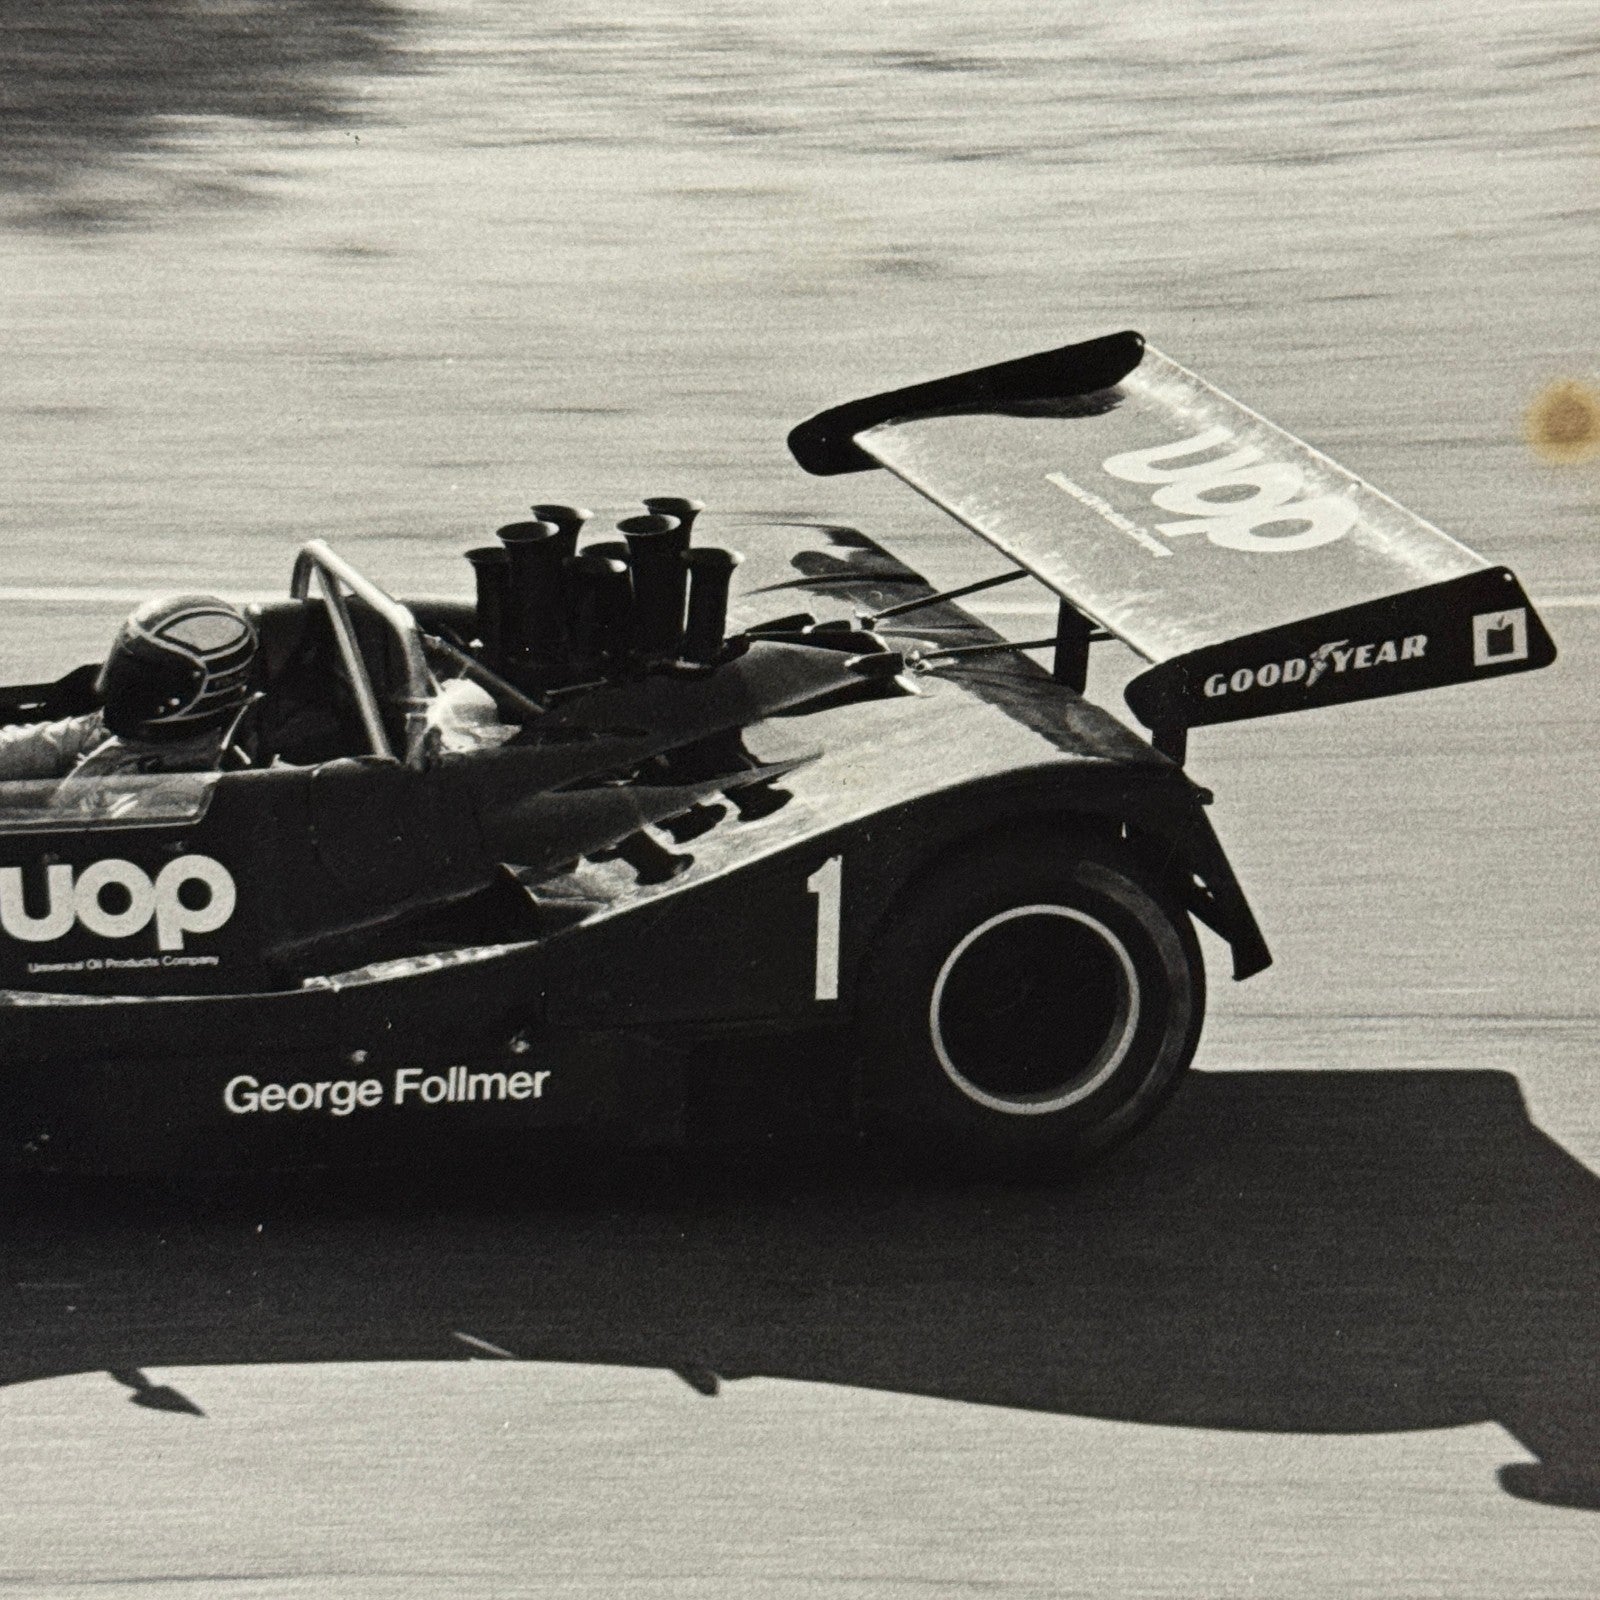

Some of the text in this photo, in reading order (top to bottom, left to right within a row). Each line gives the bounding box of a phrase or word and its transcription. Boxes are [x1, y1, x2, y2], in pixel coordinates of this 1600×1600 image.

[807, 855, 842, 1000] 1
[105, 957, 160, 969] Products
[162, 955, 219, 967] Company
[224, 1066, 551, 1116] George Follmer
